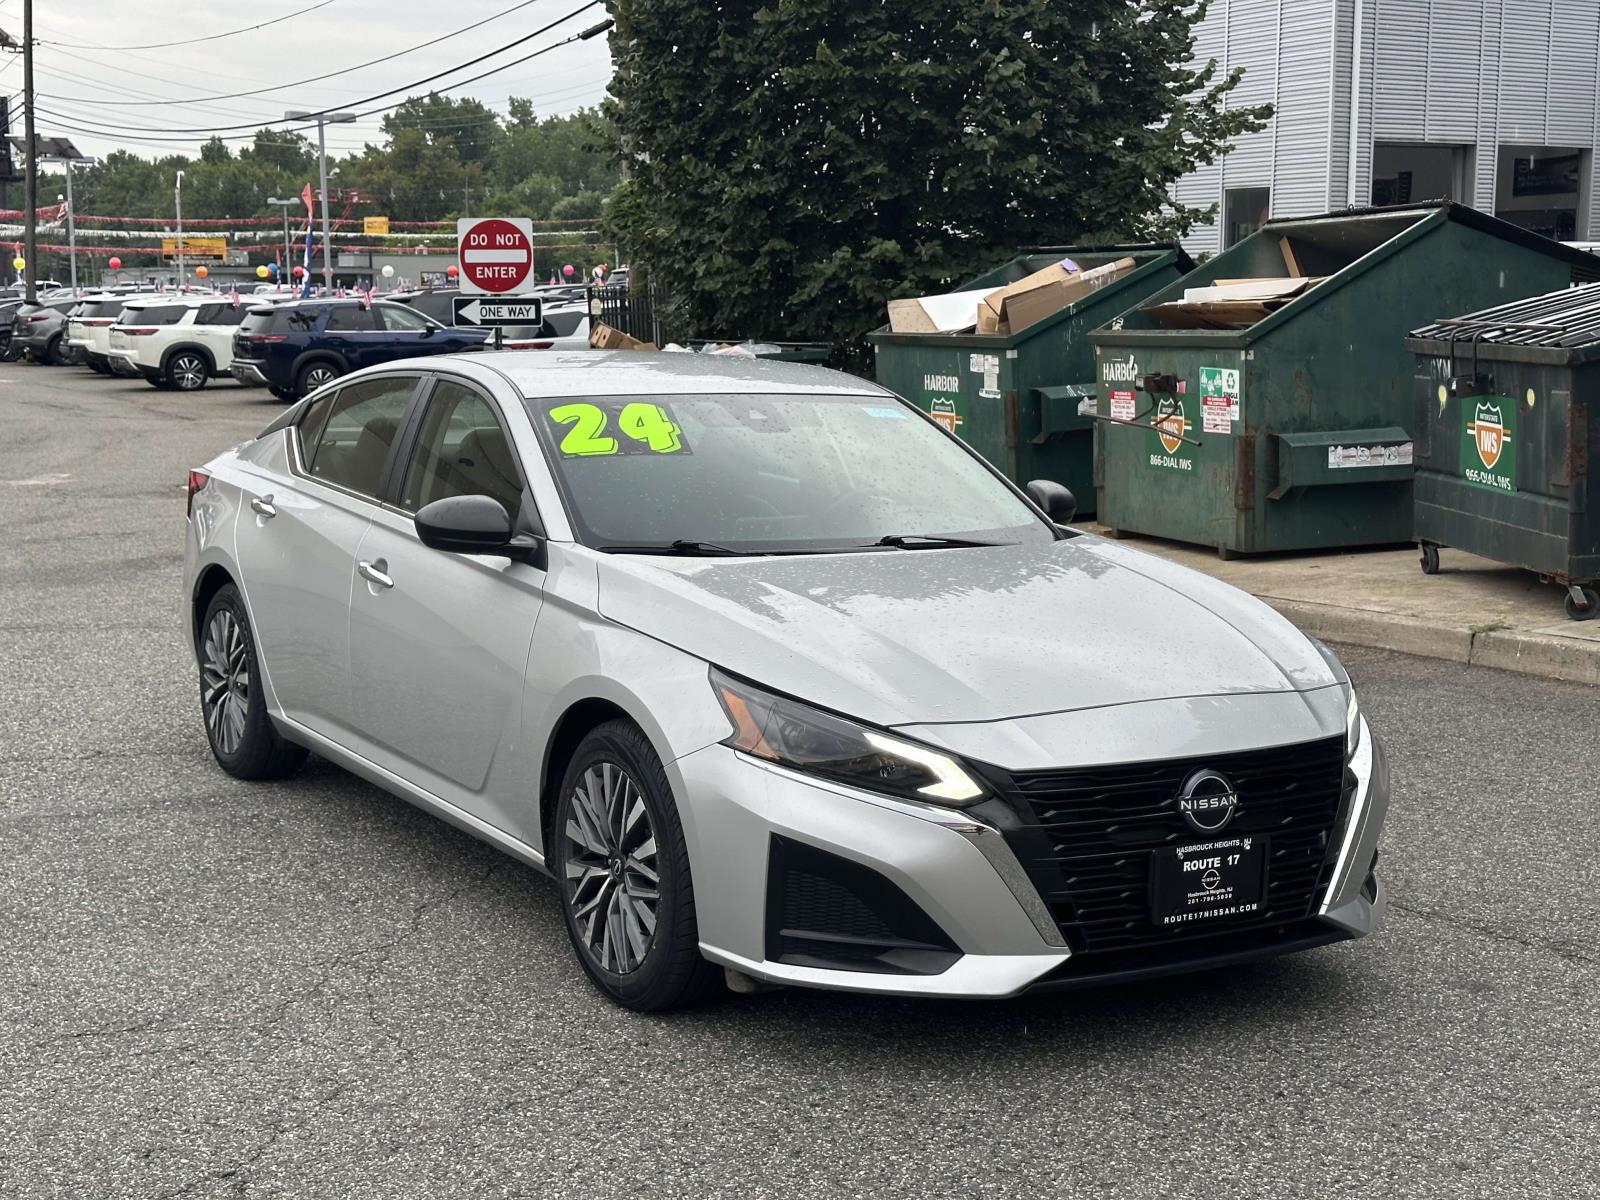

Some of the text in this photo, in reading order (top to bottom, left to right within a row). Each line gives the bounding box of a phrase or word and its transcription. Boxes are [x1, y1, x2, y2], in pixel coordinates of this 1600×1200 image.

[470, 234, 520, 246] DO NOT
[476, 266, 517, 278] ENTER
[480, 306, 532, 318] ONE WAY
[924, 374, 959, 393] HARBOR
[549, 402, 682, 456] 24
[1480, 430, 1498, 454] IWS
[1150, 454, 1192, 470] 866-DIAL IWS
[1180, 794, 1238, 810] NISSAN
[1176, 842, 1213, 854] HASBROUCK
[1183, 854, 1240, 872] ROUTE 17
[1164, 903, 1257, 924] ROUTE17NISSAN.COM
